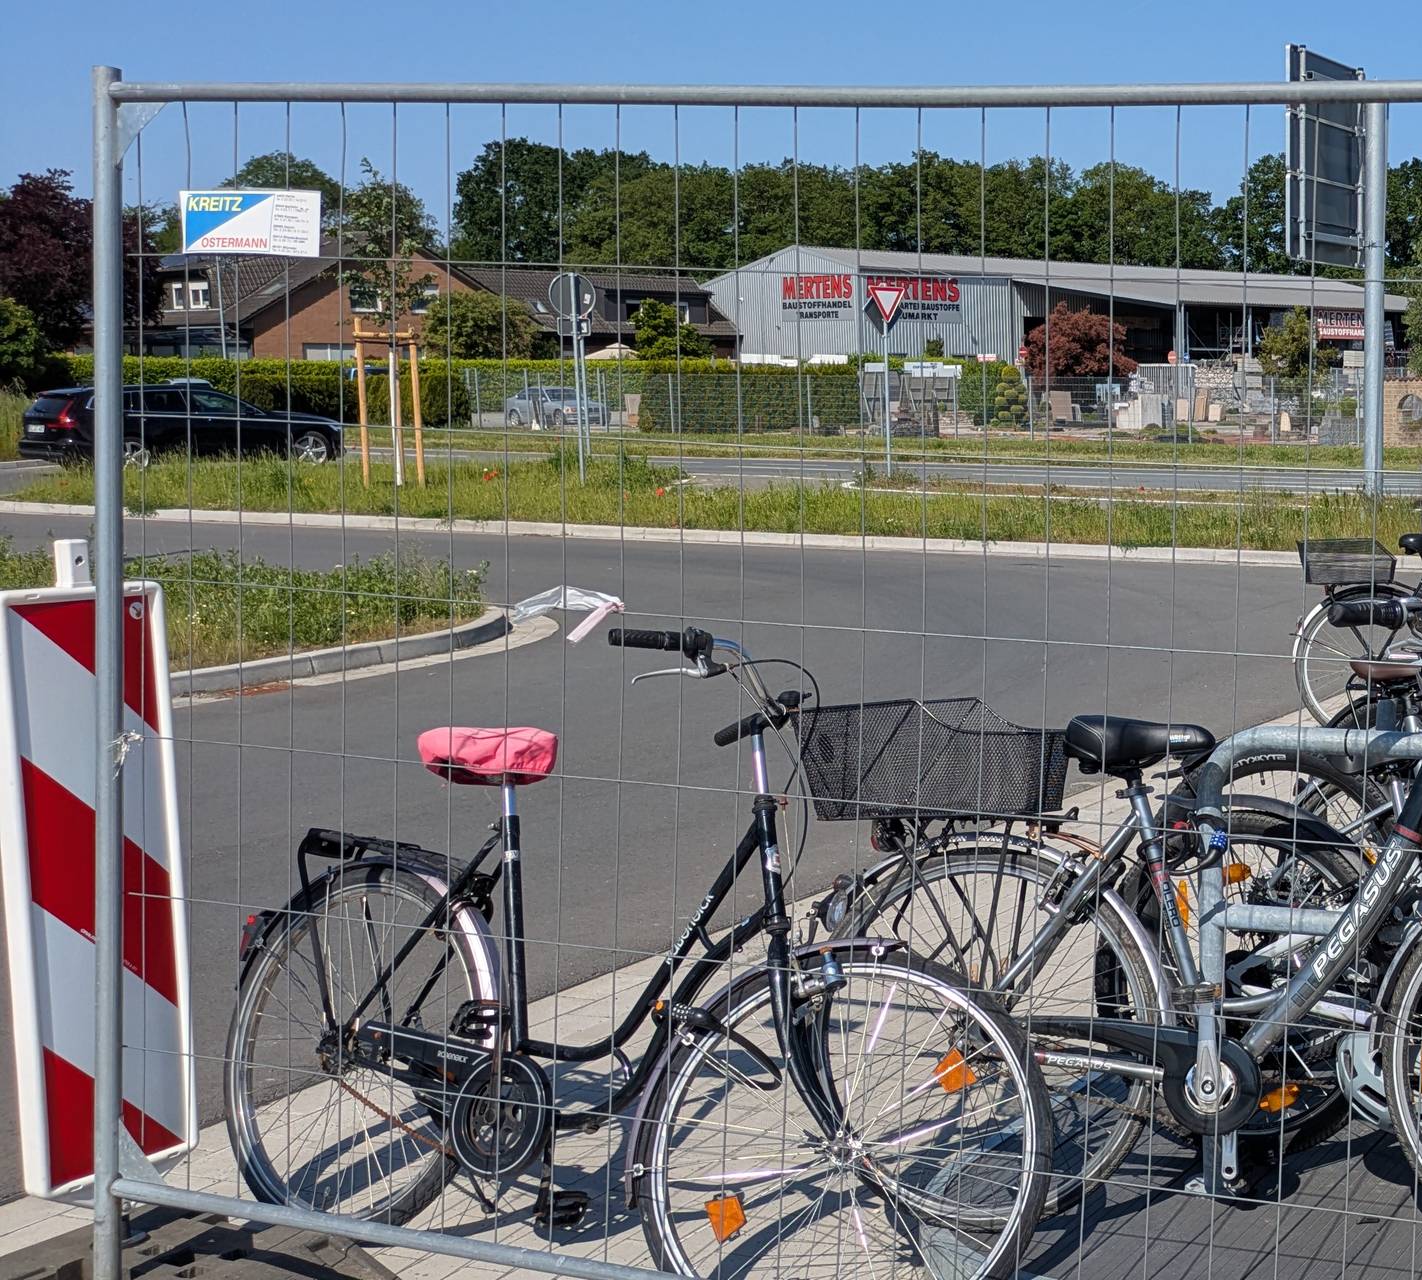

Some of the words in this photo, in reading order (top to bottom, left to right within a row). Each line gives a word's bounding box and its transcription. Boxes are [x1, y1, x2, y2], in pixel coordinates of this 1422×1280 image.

[188, 196, 243, 212] KREITZ
[201, 237, 268, 249] OSTERMANN
[782, 275, 853, 300] MERTENS
[782, 301, 853, 310] BAUSTOFFHANDEL
[921, 303, 960, 312] BAUSTOFFE
[901, 313, 938, 321] UMARKT
[1318, 311, 1365, 328] MERTEN
[1162, 874, 1181, 928] OLERO
[1311, 838, 1404, 982] PEGASUS
